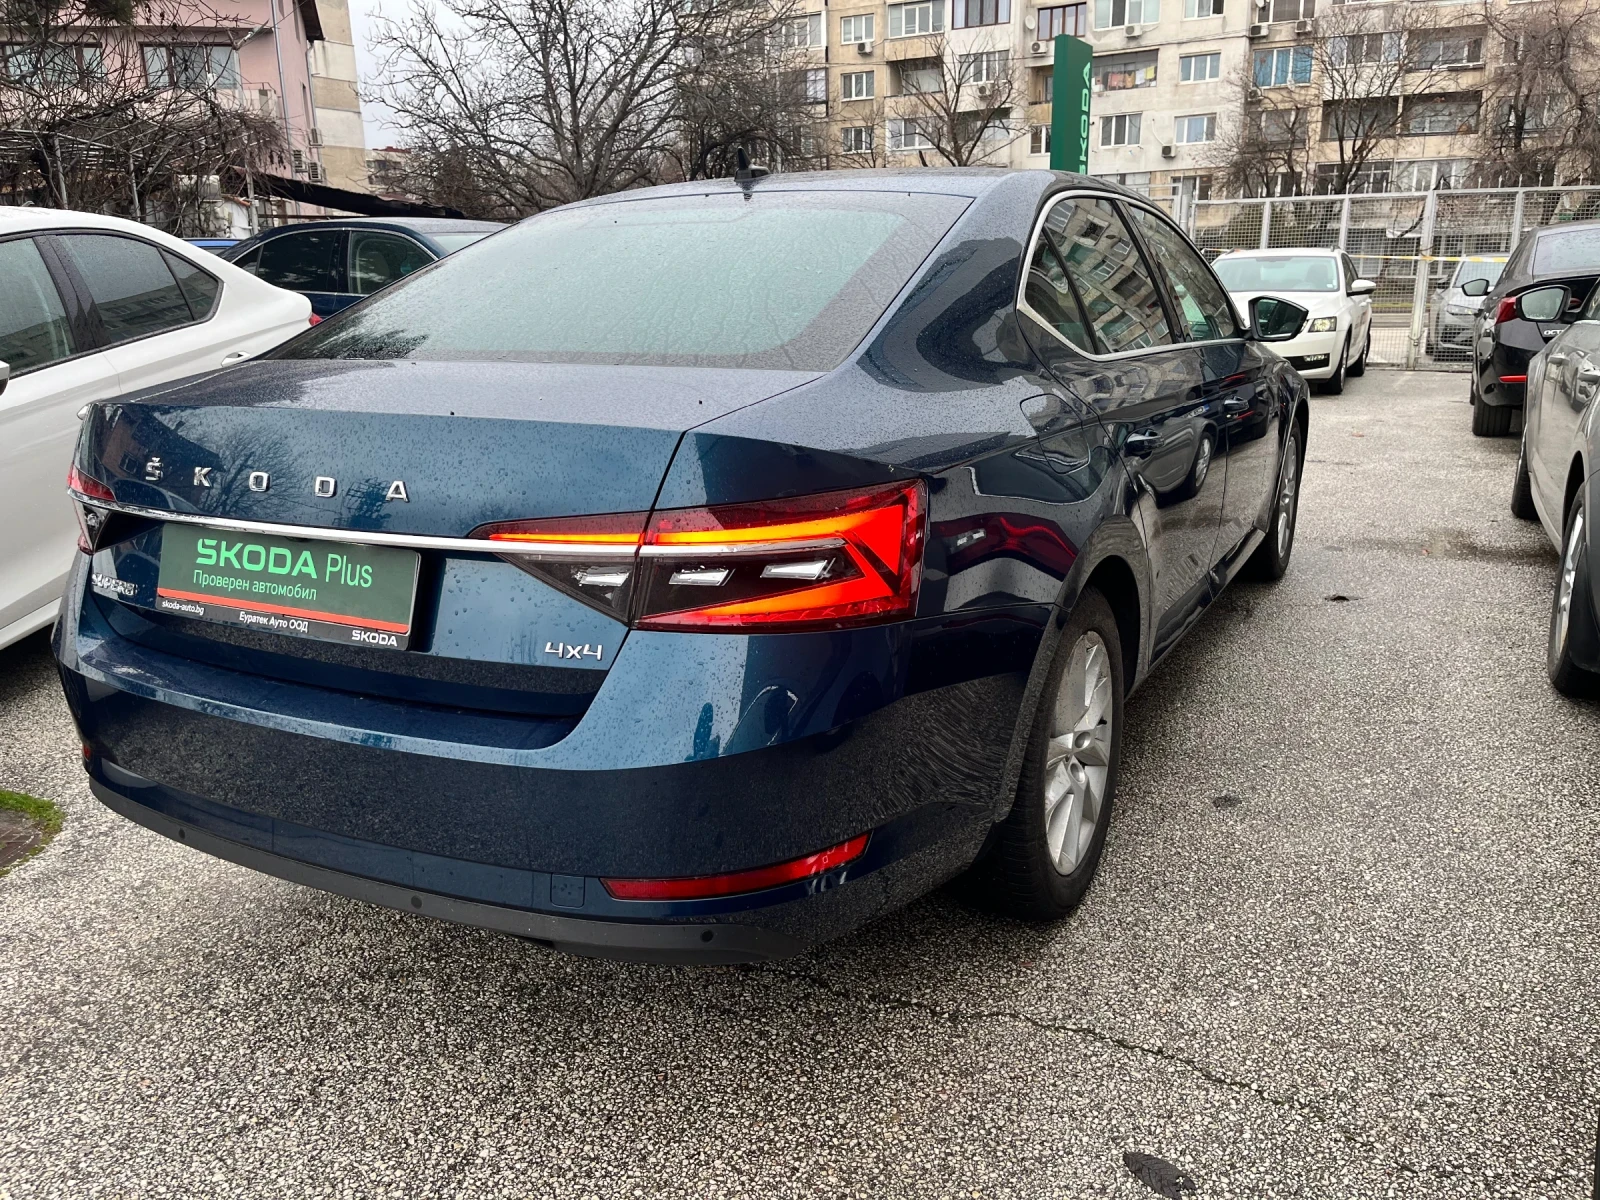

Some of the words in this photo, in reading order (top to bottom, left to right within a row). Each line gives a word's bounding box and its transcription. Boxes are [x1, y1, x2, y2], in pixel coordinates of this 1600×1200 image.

[145, 457, 409, 502] ŠKODA
[196, 538, 318, 579] SKODA
[325, 553, 373, 588] Plus
[193, 569, 250, 592] Проверен
[252, 579, 317, 600] автомобил
[161, 600, 205, 616] skoda-auto.bg
[239, 611, 269, 625] Еуратек
[269, 616, 288, 629] Ауто
[289, 619, 309, 633] ООД
[351, 629, 398, 647] SKODA
[544, 641, 603, 660] 4x4
